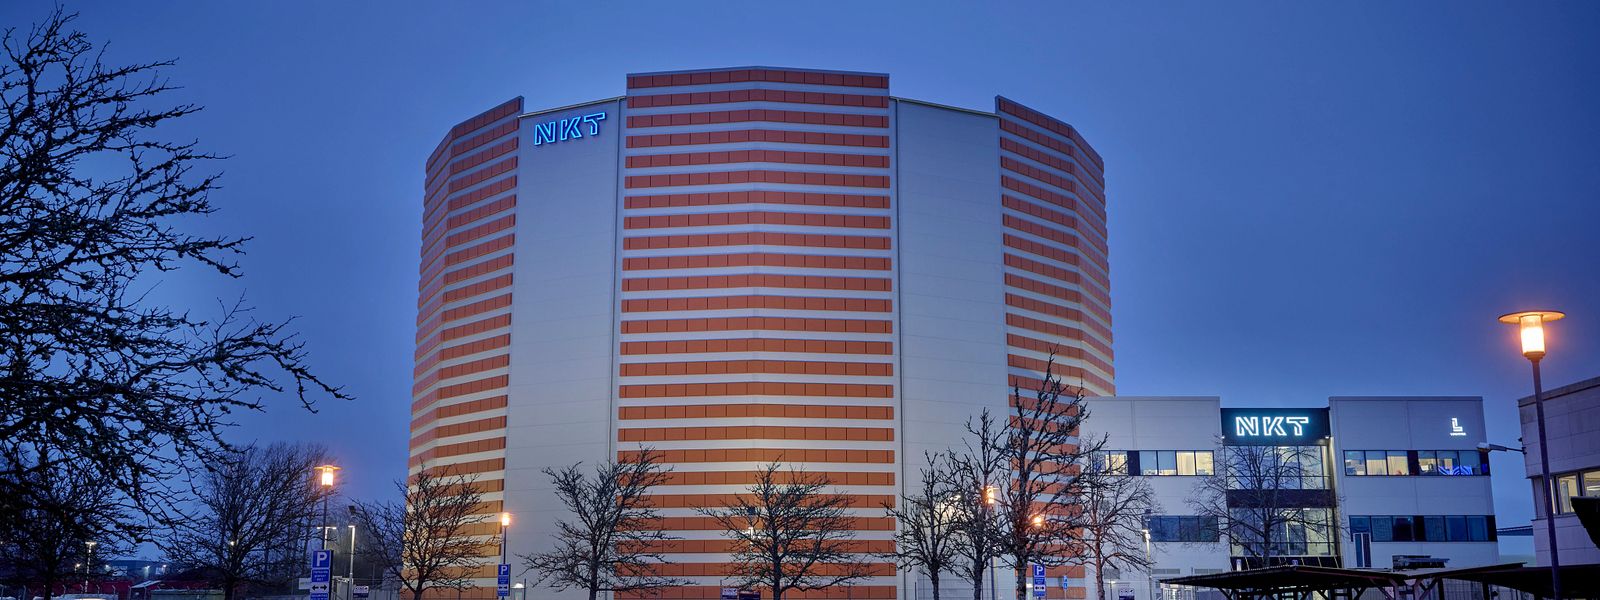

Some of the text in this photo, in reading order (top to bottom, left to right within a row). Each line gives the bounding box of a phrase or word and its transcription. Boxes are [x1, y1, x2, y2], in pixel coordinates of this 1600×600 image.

[534, 112, 606, 145] NKT
[1235, 416, 1309, 436] NKT
[316, 552, 327, 566] P
[501, 565, 508, 575] P
[1036, 566, 1044, 575] P
